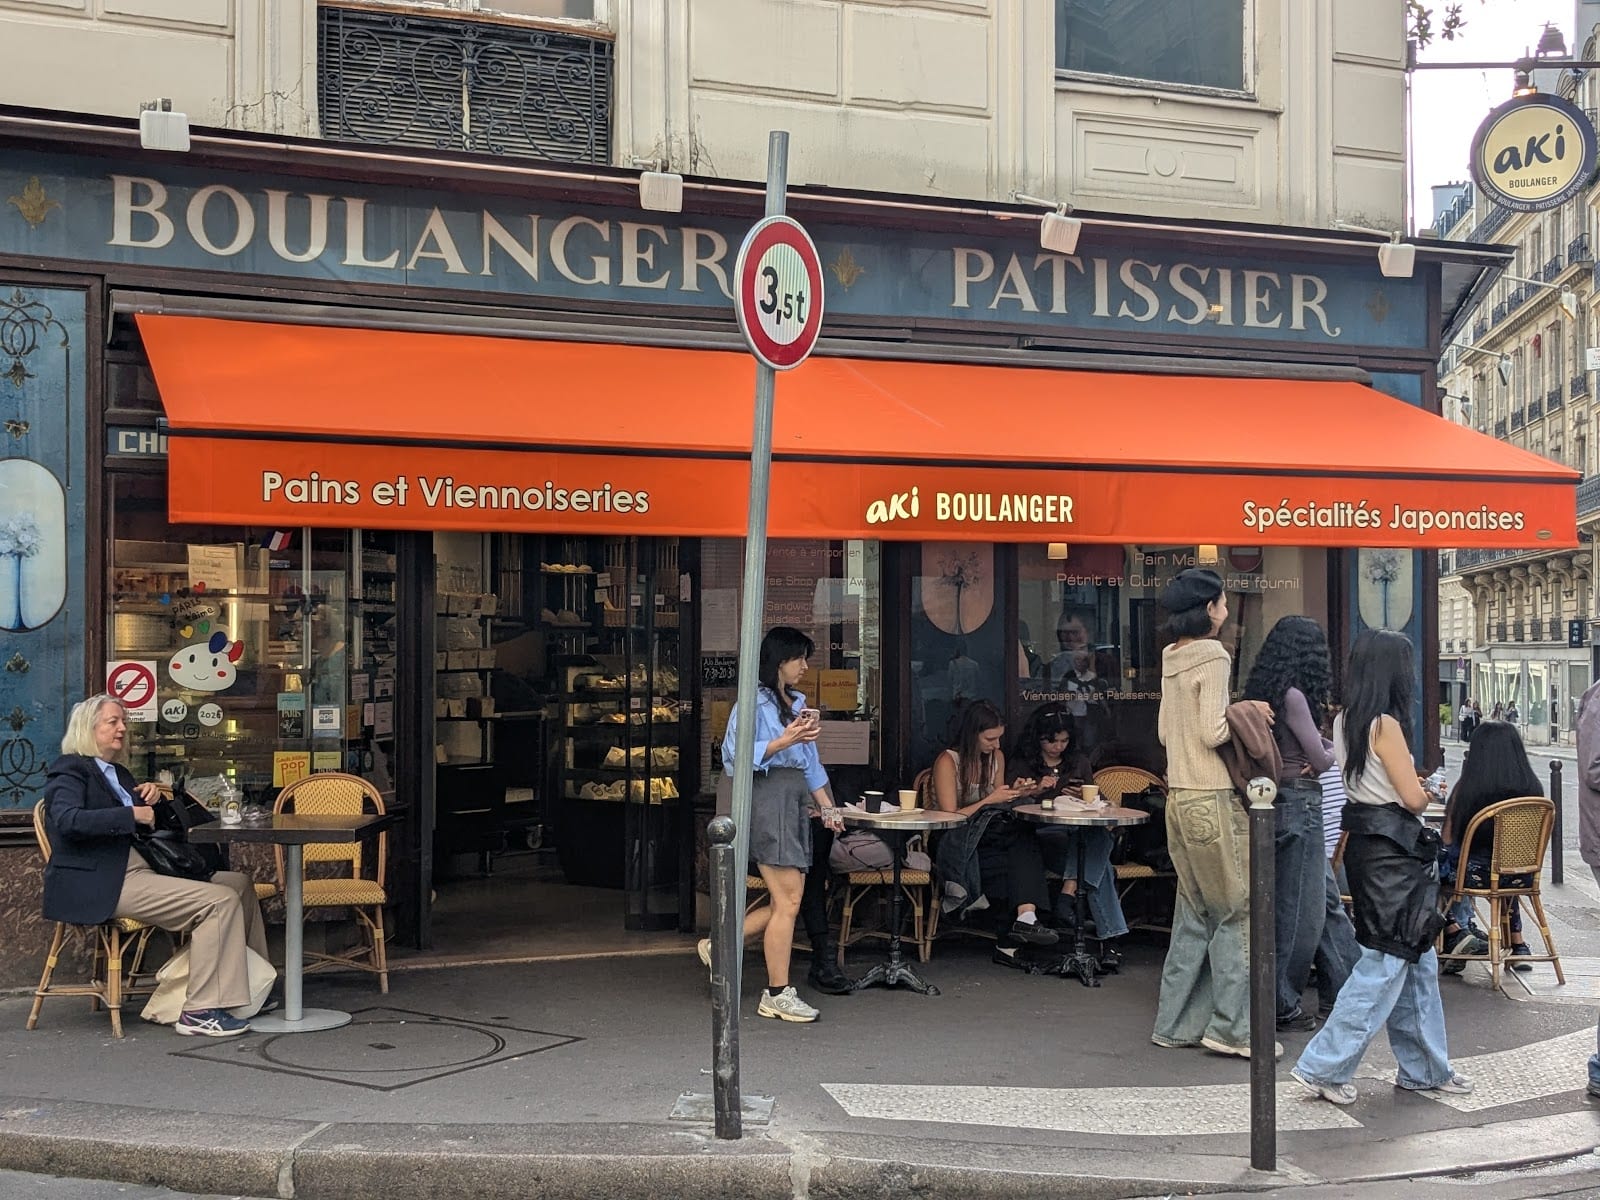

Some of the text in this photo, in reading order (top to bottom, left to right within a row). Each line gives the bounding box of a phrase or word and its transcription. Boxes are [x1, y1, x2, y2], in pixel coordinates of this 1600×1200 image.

[1494, 124, 1565, 173] aki
[1509, 176, 1558, 188] BOULANGER
[108, 174, 733, 299] BOULANGER
[952, 246, 1341, 338] PATISSIER
[262, 471, 650, 513] Pains et Viennoiseries
[866, 486, 1074, 524] aki BOULANGER
[1242, 498, 1525, 535] Spécialités Japonaises
[1134, 552, 1166, 566] Pain
[1056, 572, 1102, 588] Pétrit
[1108, 575, 1124, 587] et
[1255, 576, 1300, 589] fournil
[1022, 690, 1089, 701] Viennoiseries
[164, 705, 185, 715] aki
